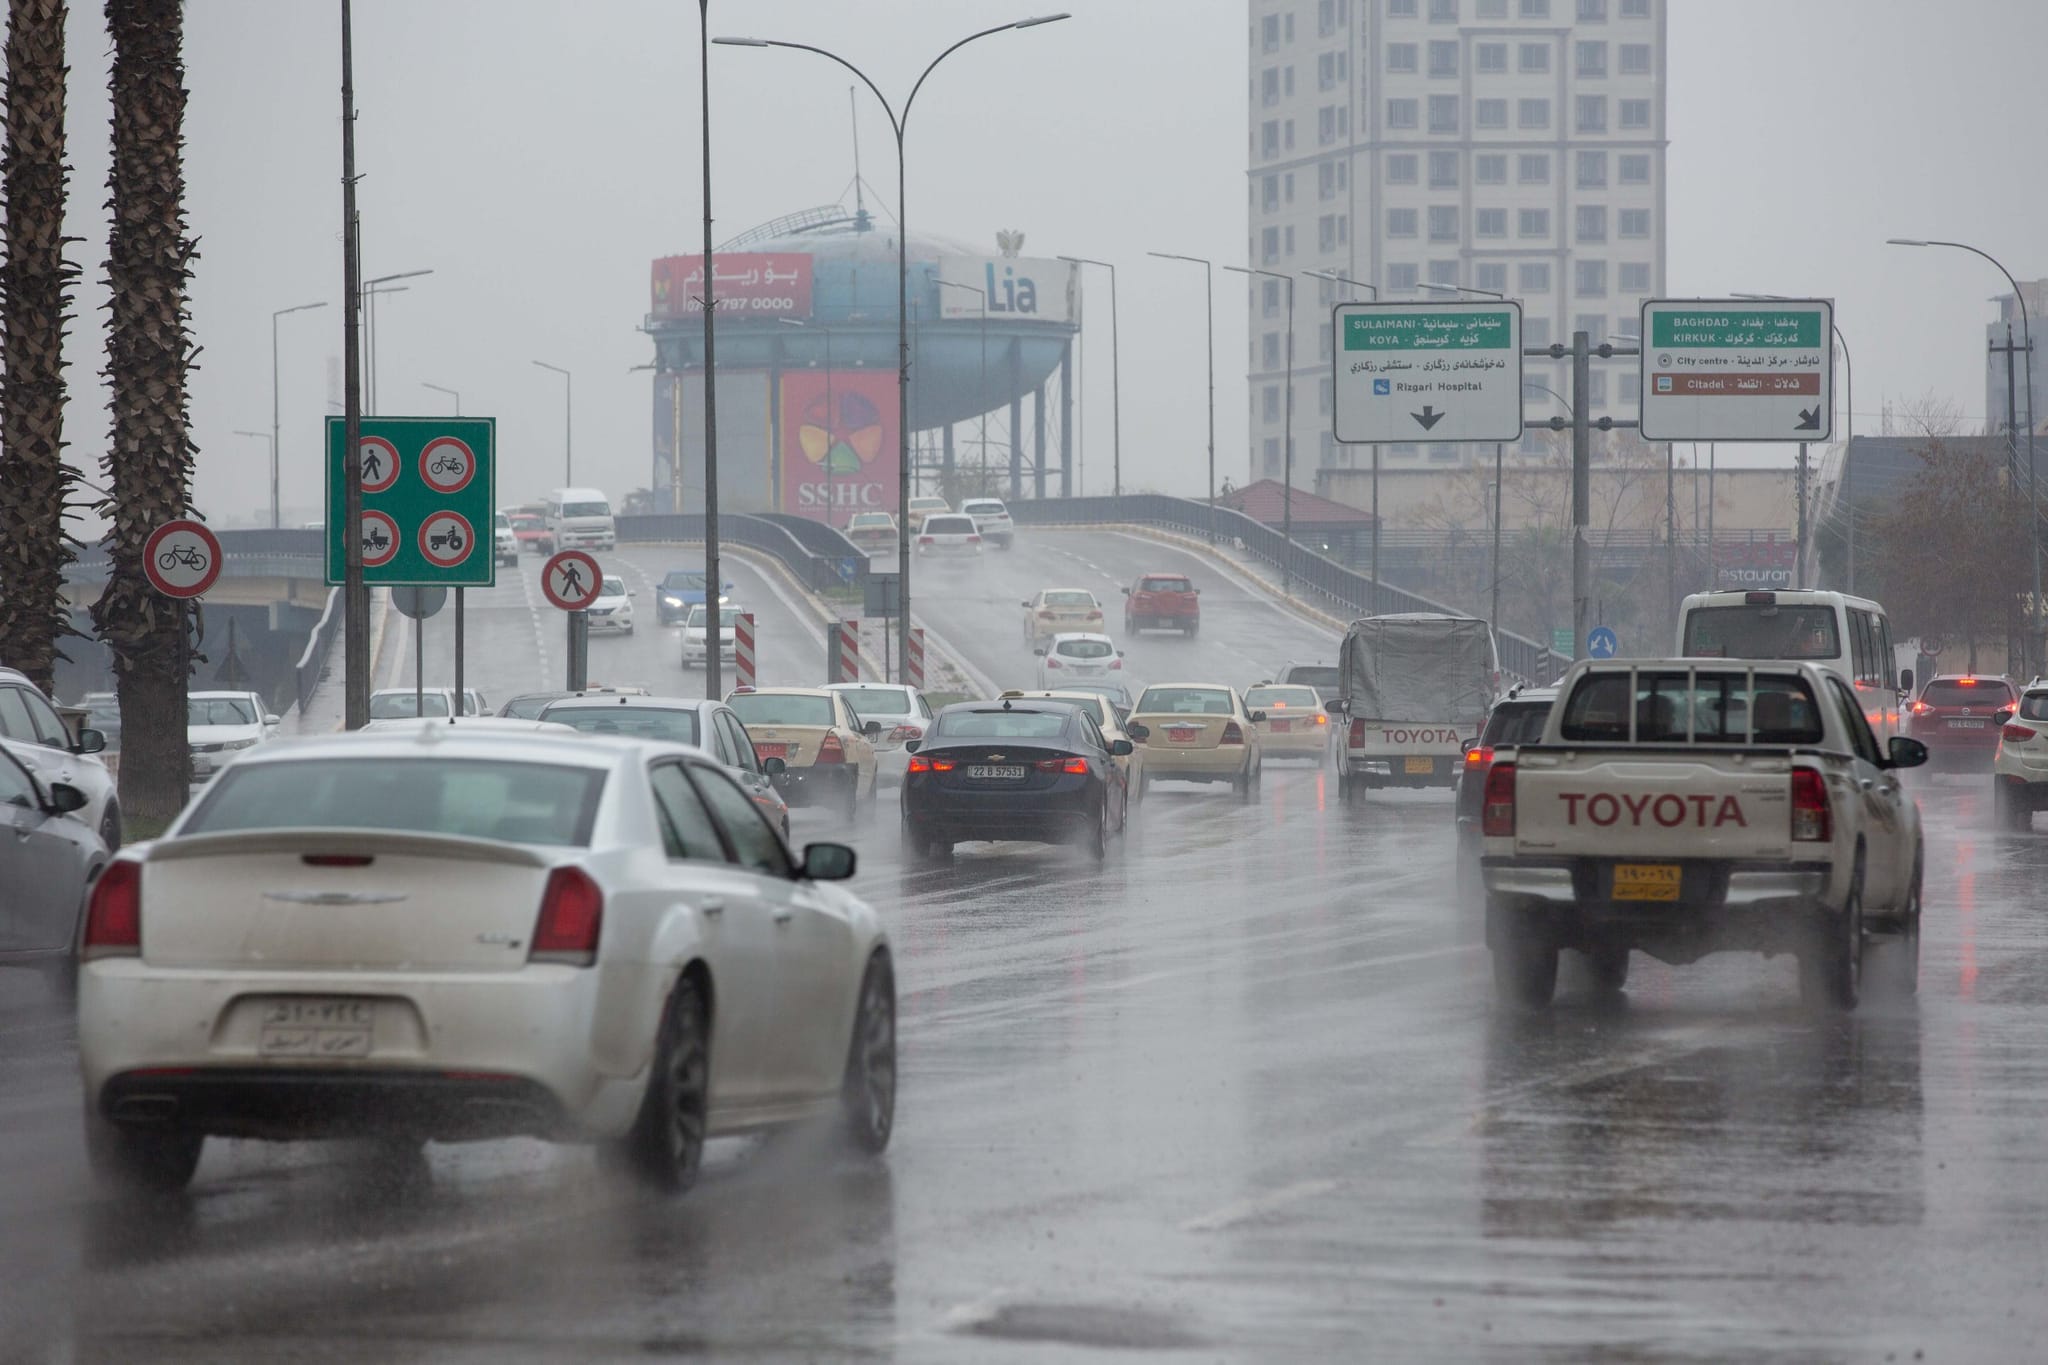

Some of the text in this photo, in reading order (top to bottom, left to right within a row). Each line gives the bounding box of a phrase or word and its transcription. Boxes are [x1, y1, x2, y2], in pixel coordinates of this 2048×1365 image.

[985, 262, 1037, 313] Lia
[722, 298, 747, 309] 797
[752, 297, 793, 309] 0000
[1354, 320, 1416, 329] SULAIMANI
[1673, 318, 1729, 327] BAGHDAD
[1741, 317, 1764, 331] بغداد
[1369, 335, 1399, 345] KOYA
[1673, 333, 1716, 343] KIRKUK
[1677, 356, 1728, 367] City centre
[1396, 381, 1482, 393] Rizgari Hospital
[1687, 378, 1725, 389] Citadel
[799, 482, 884, 506] SSHC
[1382, 729, 1460, 744] TOYOTA
[974, 767, 985, 777] 22
[1559, 793, 1748, 828] TOYOTA
